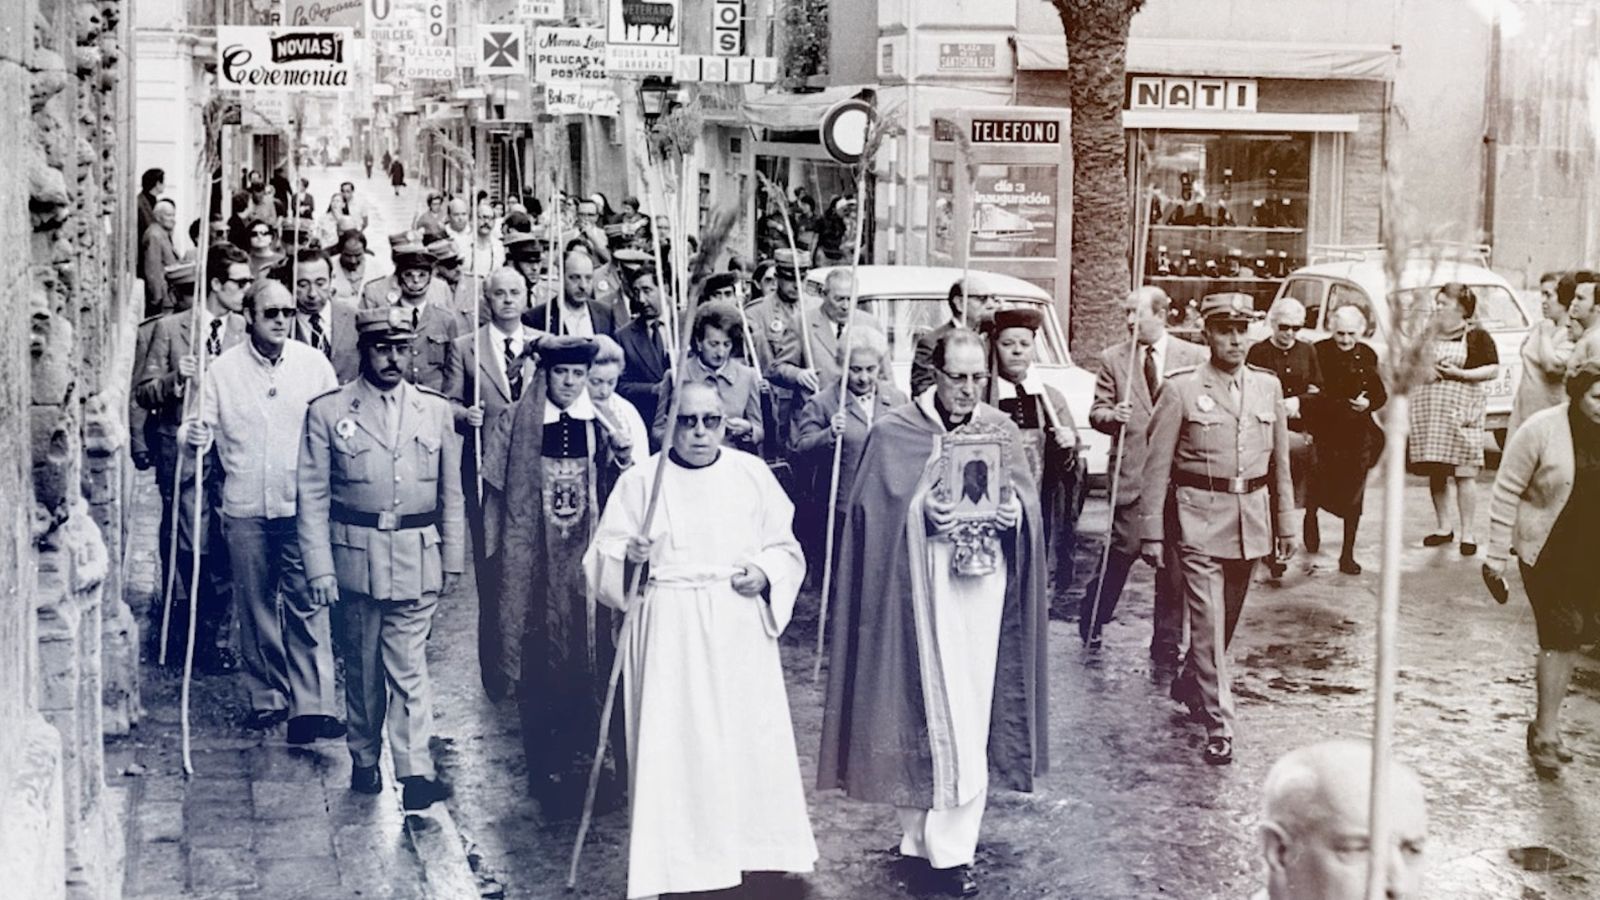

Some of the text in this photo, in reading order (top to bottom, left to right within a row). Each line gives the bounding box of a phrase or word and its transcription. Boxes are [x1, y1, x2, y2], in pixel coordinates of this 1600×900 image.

[624, 4, 674, 16] VETERANO
[430, 0, 442, 37] CO
[371, 30, 415, 41] DULCES
[276, 38, 334, 58] NOVIAS
[408, 48, 452, 57] ULLOA
[222, 44, 348, 86] Ceremonia
[539, 54, 590, 65] PELUCAS
[407, 68, 453, 77] OPTICO
[679, 60, 771, 82] NATI
[1138, 83, 1247, 106] NATI
[973, 122, 1057, 142] TELEFONO
[1015, 183, 1026, 193] 3
